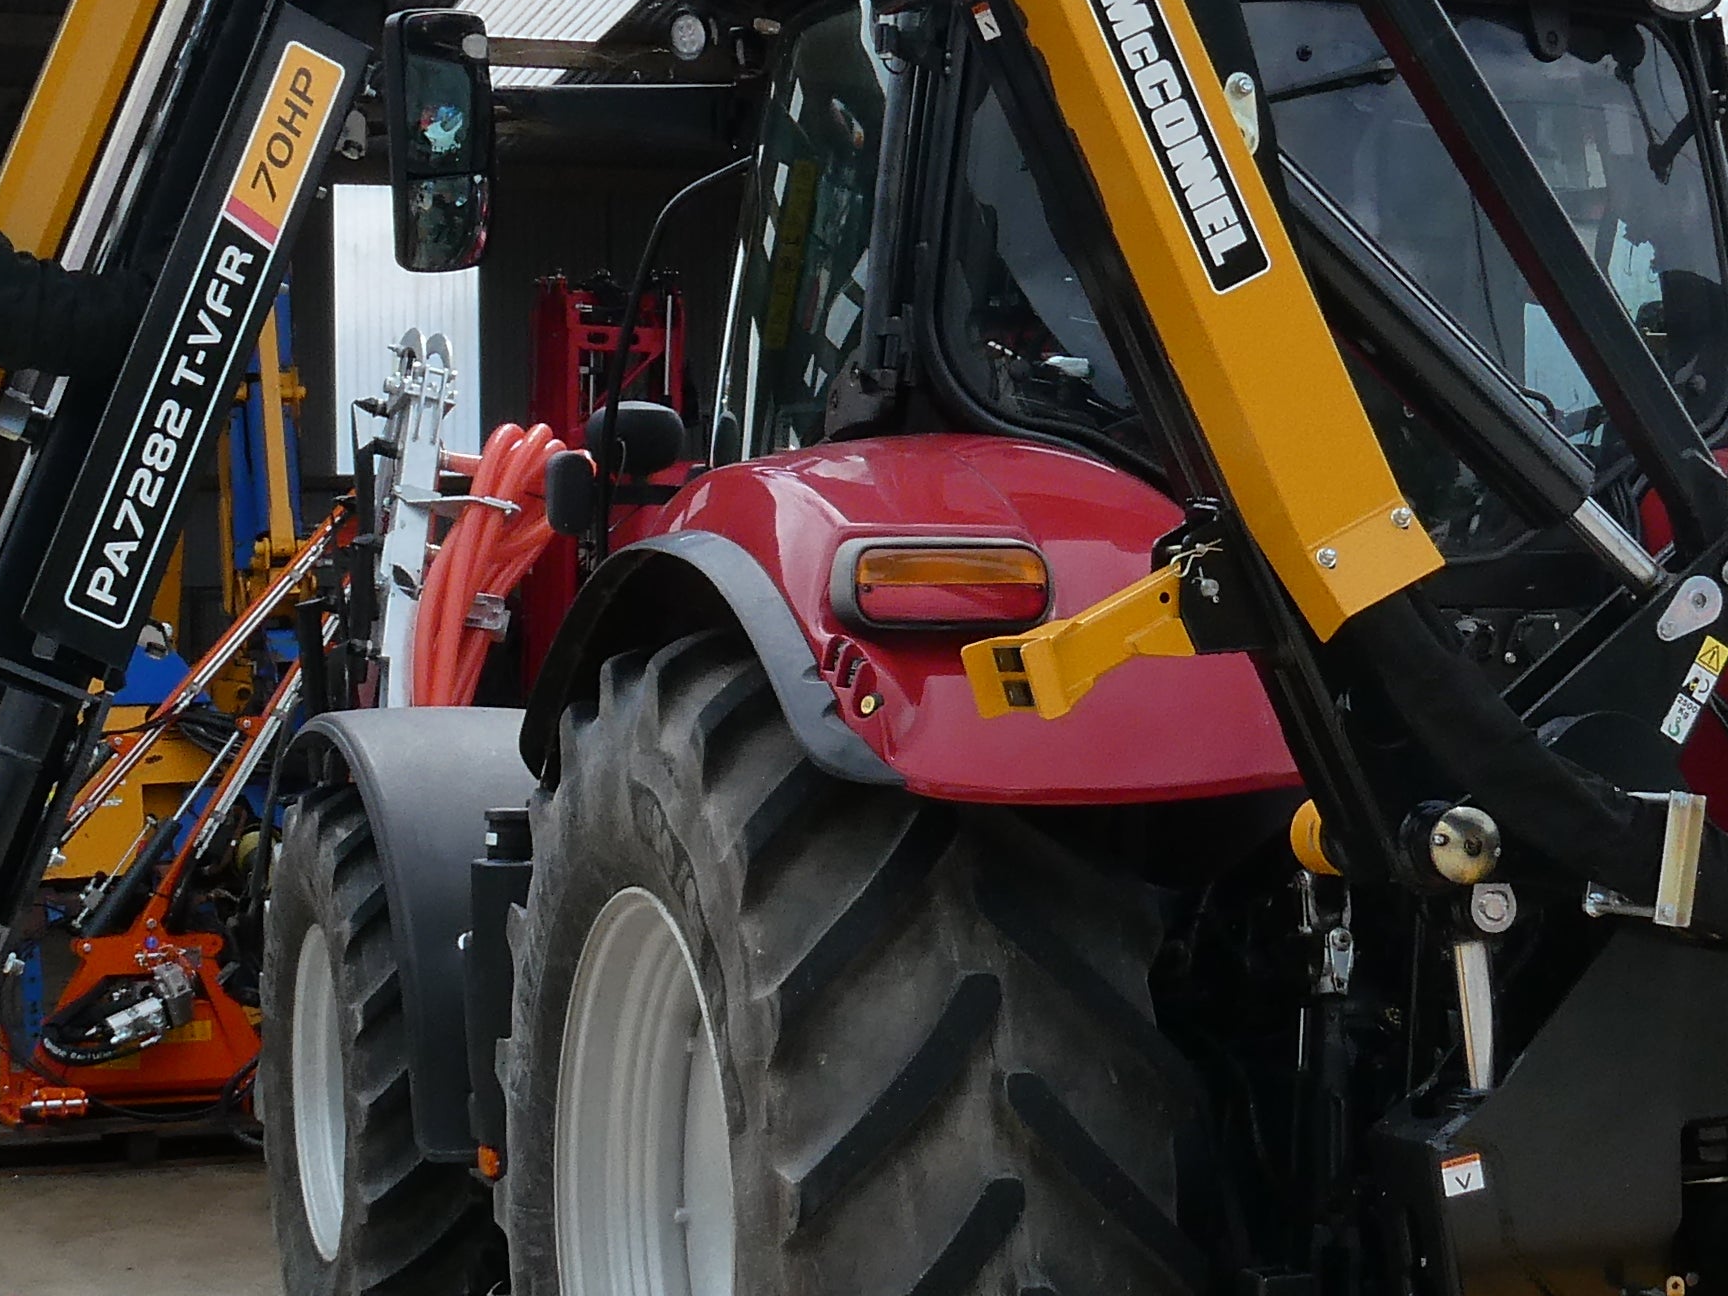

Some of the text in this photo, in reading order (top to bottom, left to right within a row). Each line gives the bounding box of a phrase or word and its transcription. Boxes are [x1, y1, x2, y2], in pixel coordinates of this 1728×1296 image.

[86, 65, 318, 608] PA7282 T-VFR 70HP
[1676, 696, 1699, 714] 2500
